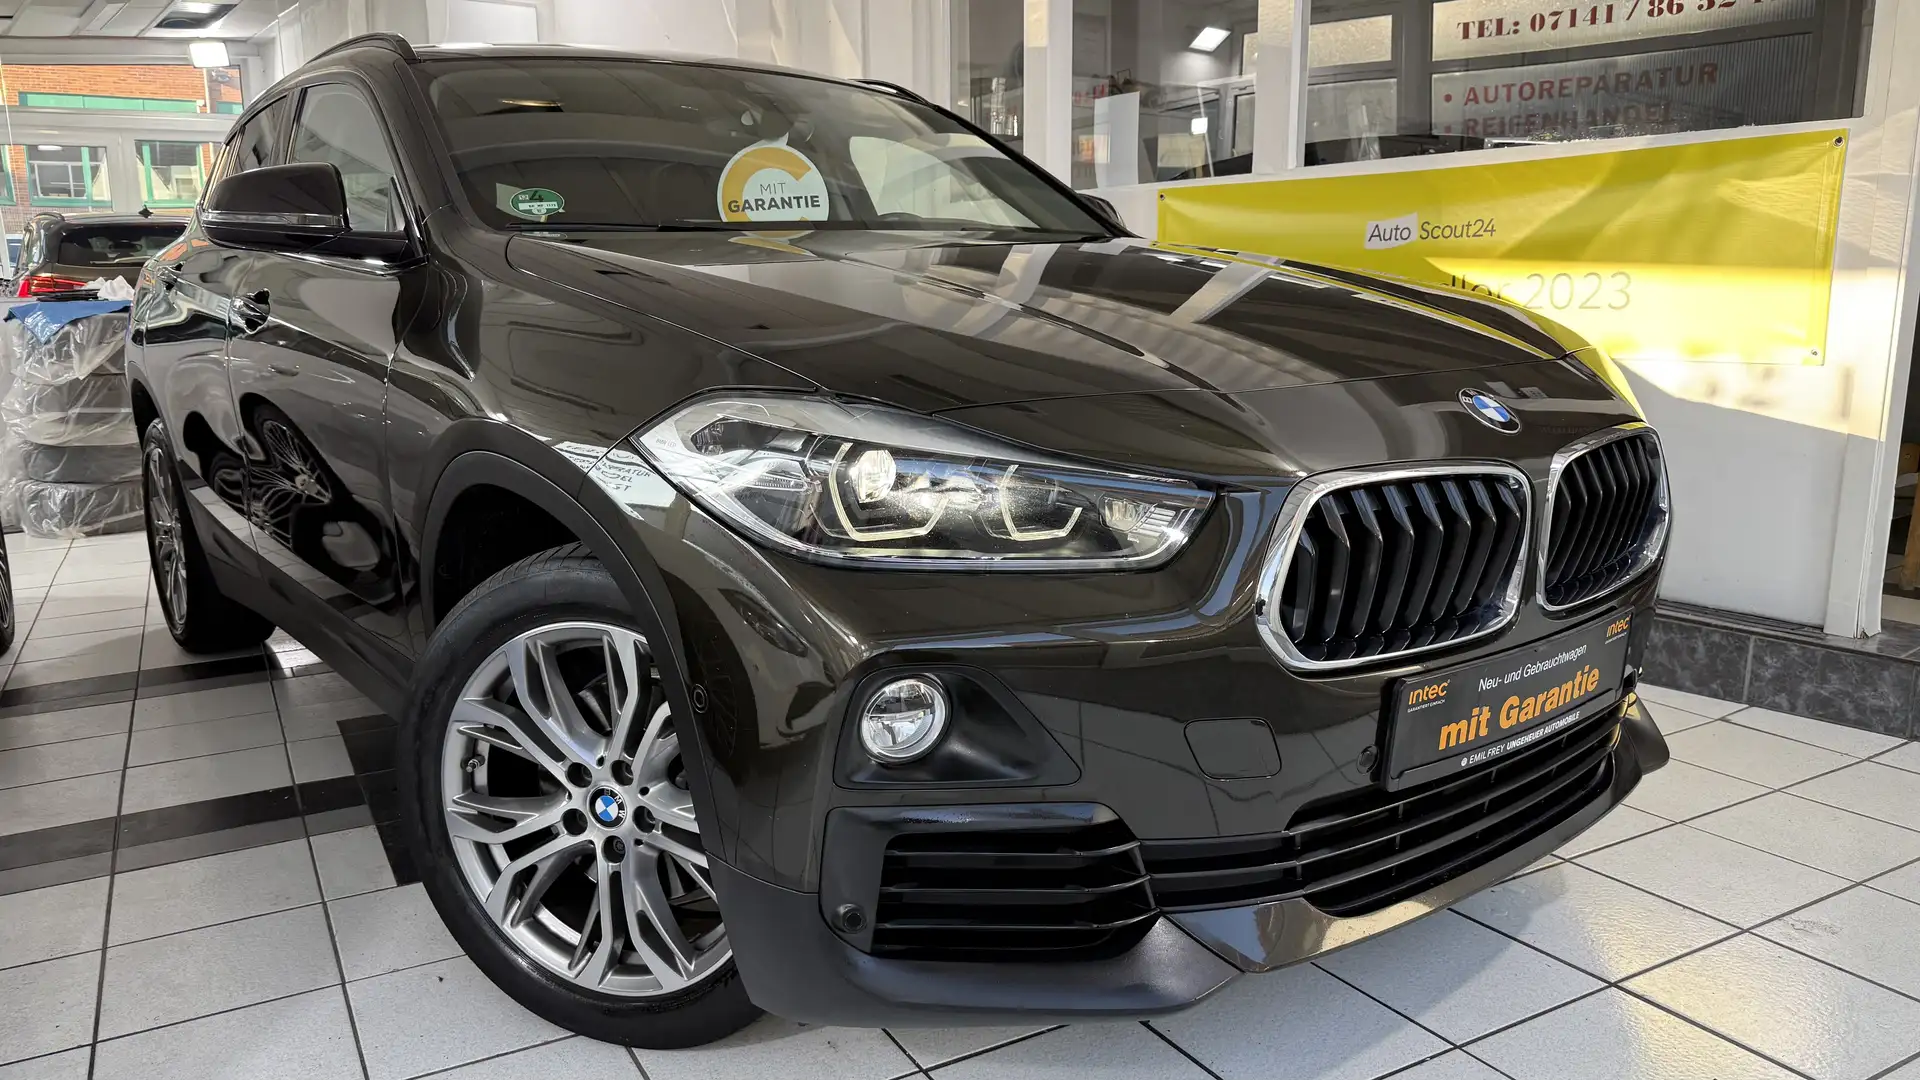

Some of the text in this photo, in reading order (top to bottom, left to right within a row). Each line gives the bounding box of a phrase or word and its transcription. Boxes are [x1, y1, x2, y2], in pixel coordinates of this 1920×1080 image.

[1457, 17, 1520, 39] TEL:
[1530, 4, 1614, 32] 07141
[1647, 0, 1684, 17] 86
[1464, 63, 1719, 106] AUTOREPARATUR
[529, 190, 544, 203] 4
[727, 195, 821, 213] GARANTIE
[760, 181, 786, 195] MIT
[1368, 218, 1497, 242] Auto Scout24
[1522, 271, 1632, 310] 2023
[1478, 644, 1587, 692] Neu- und Gebrauchtwagen
[1408, 681, 1449, 705] intec
[1438, 665, 1601, 750] mit Garantie
[1469, 711, 1581, 765] EMIL FREY UNGEHEUER AUTOMOBILE
